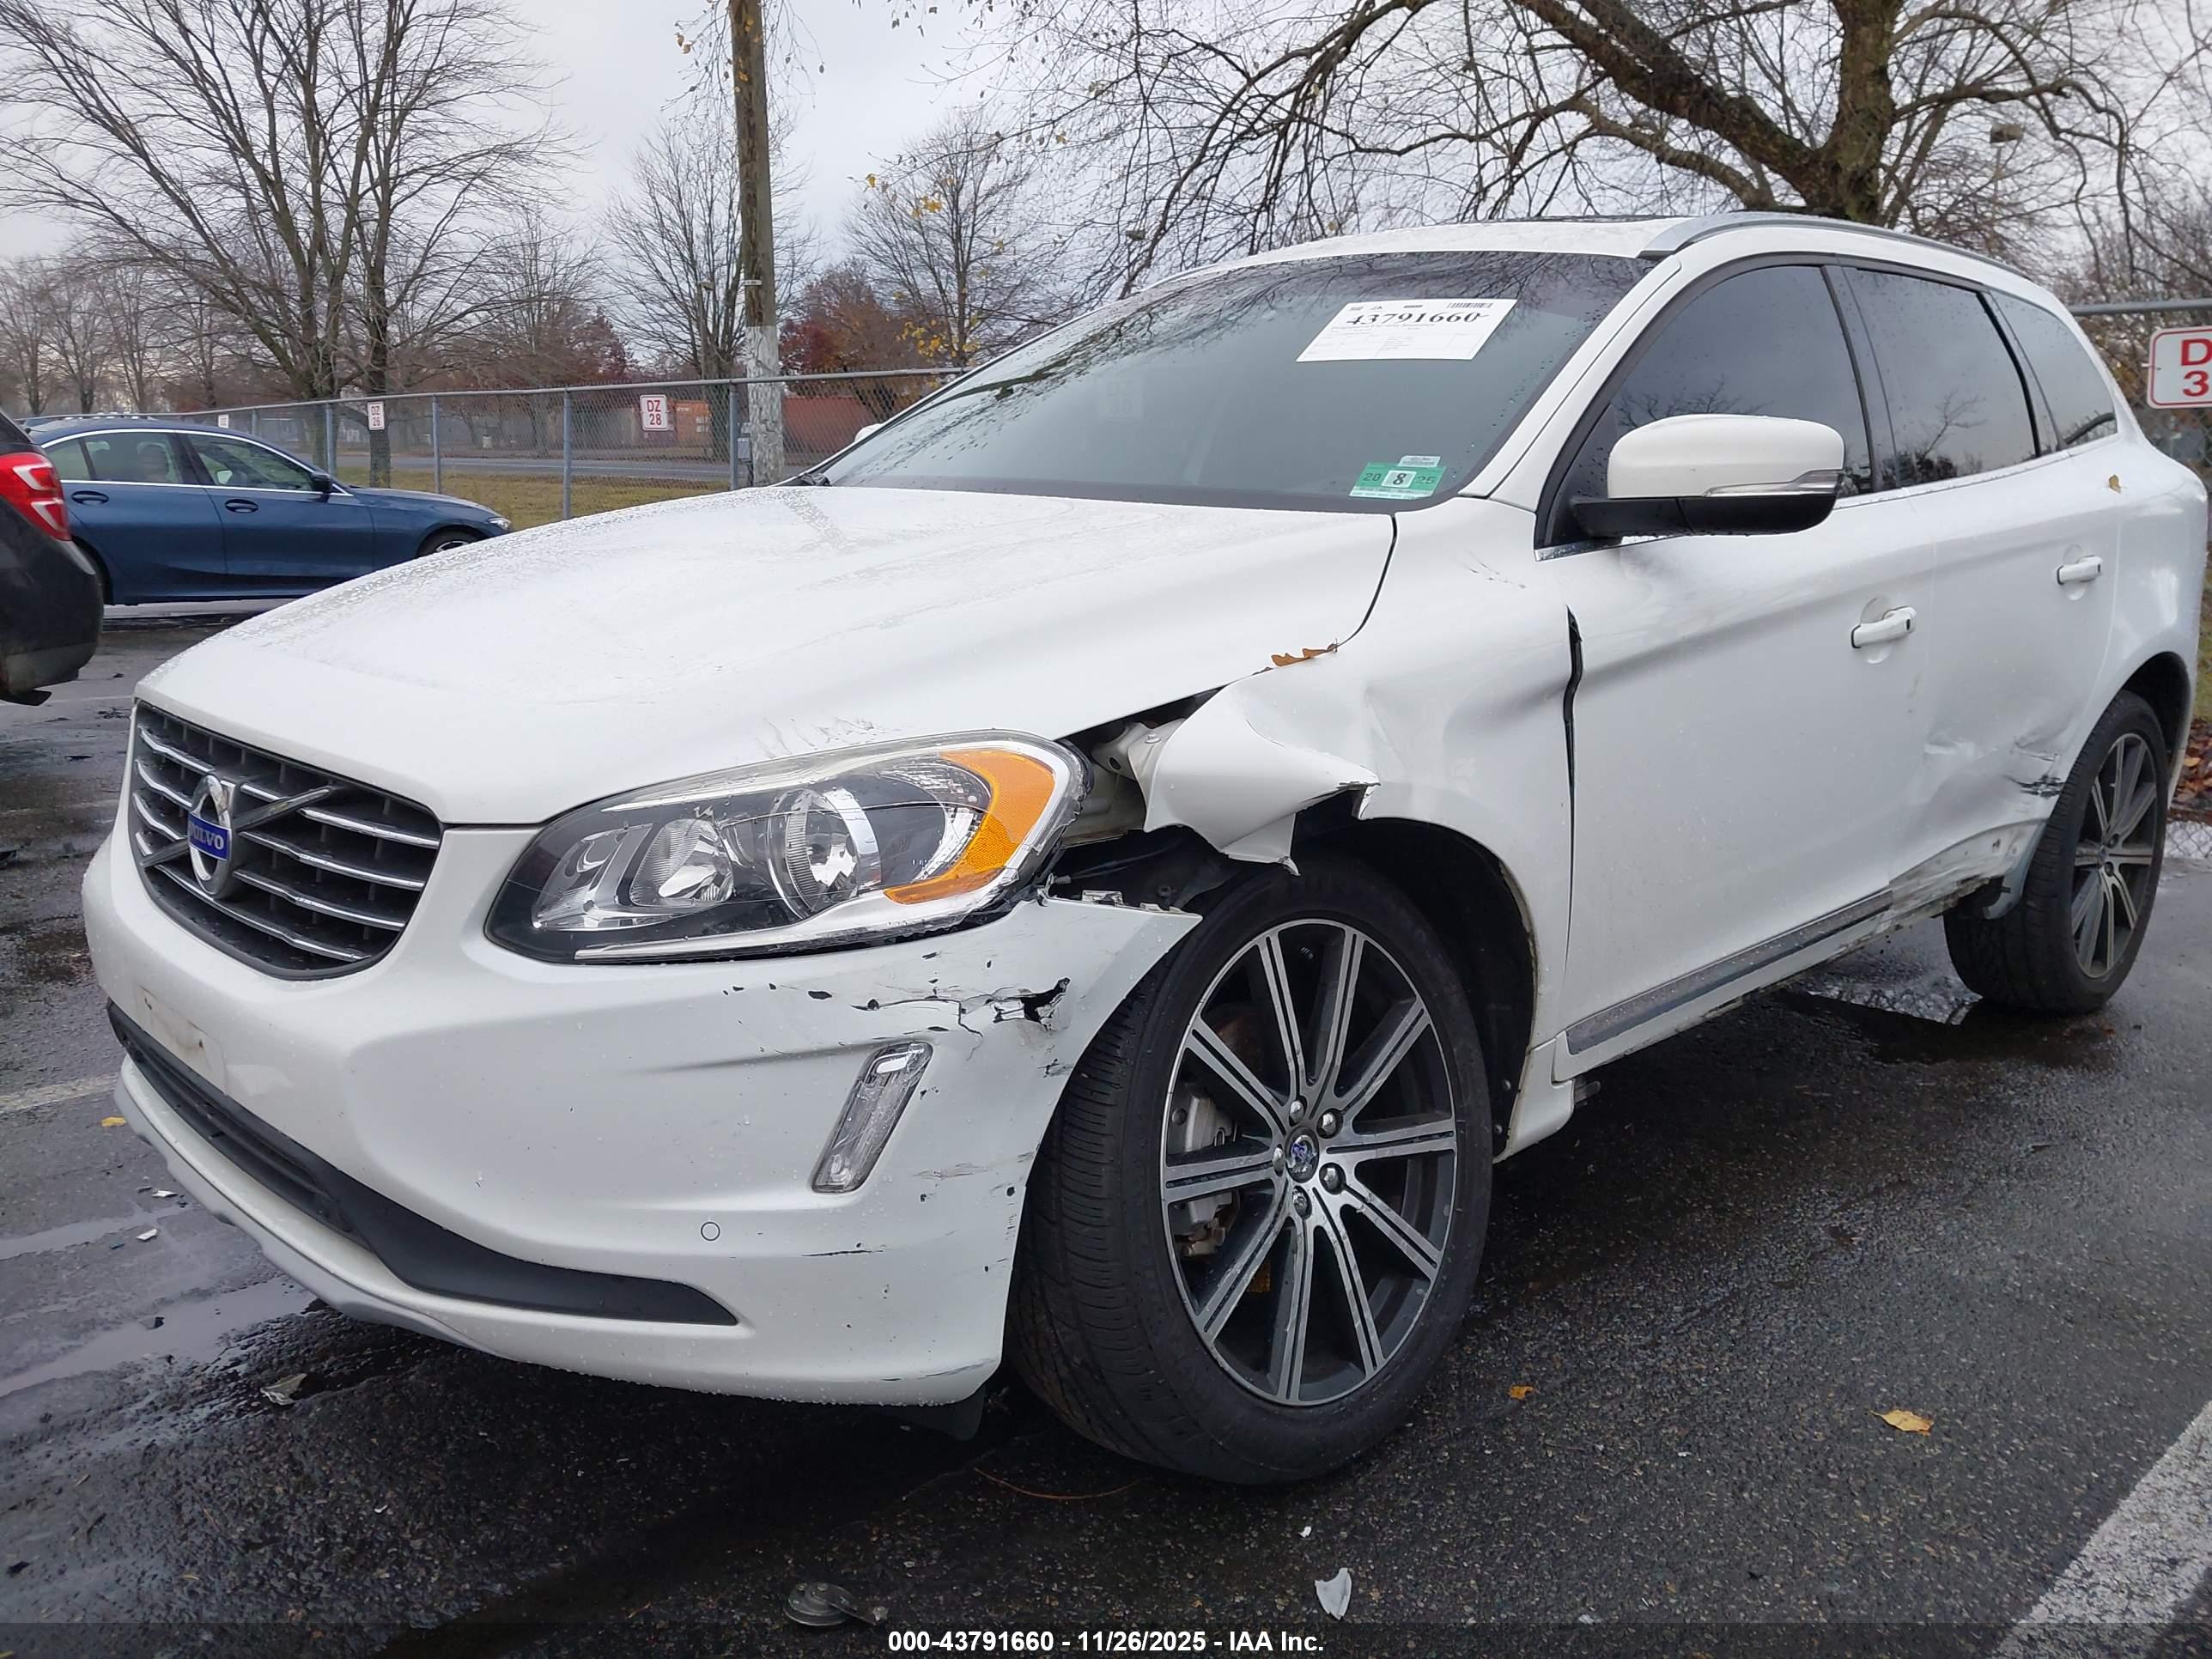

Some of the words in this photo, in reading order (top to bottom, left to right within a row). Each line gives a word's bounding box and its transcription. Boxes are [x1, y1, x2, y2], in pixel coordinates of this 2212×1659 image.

[1346, 312, 1482, 325] 43791660
[2183, 370, 2209, 397] 3
[647, 400, 661, 412] DZ
[649, 413, 661, 425] 28
[1363, 472, 1382, 482] 20
[1393, 473, 1407, 485] 8
